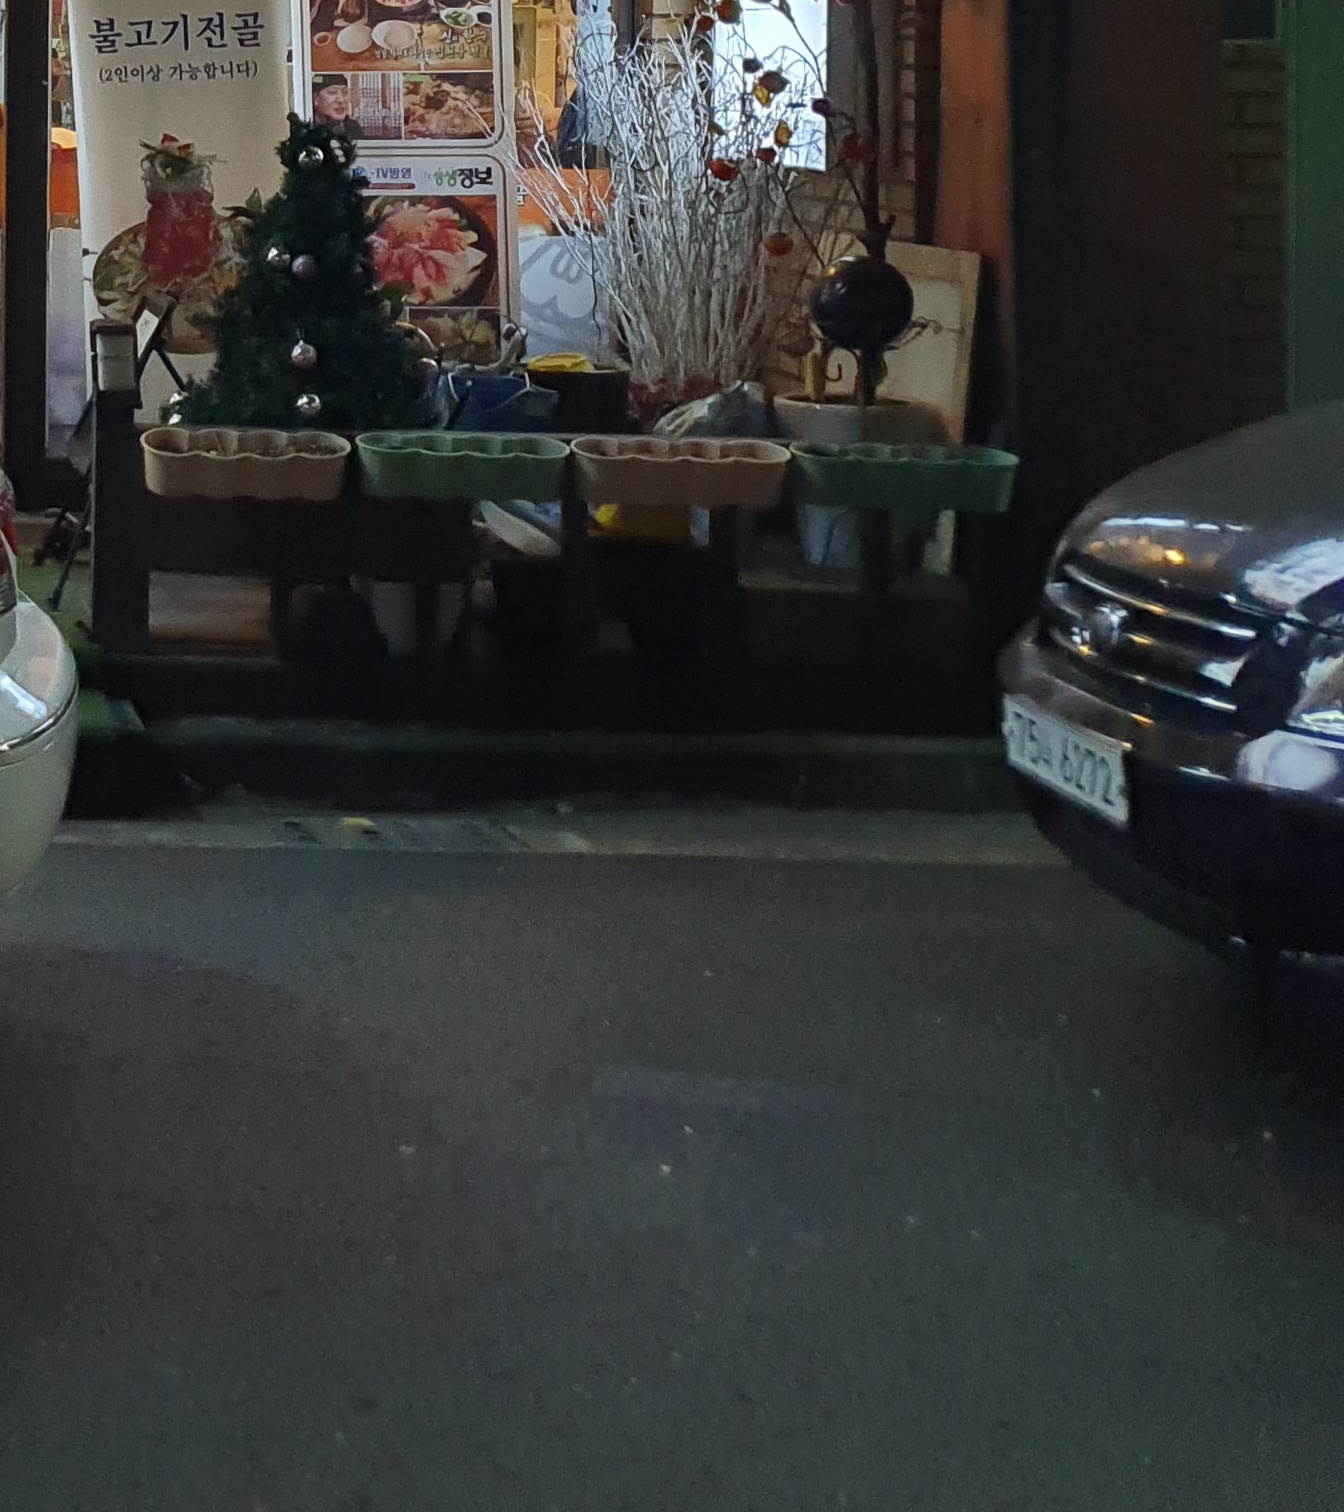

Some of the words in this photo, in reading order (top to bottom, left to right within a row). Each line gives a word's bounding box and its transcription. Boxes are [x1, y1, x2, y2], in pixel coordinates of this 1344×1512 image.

[89, 11, 265, 54] 불고기전골
[99, 63, 163, 83] (2인이상
[169, 59, 259, 82] 가능합니다)
